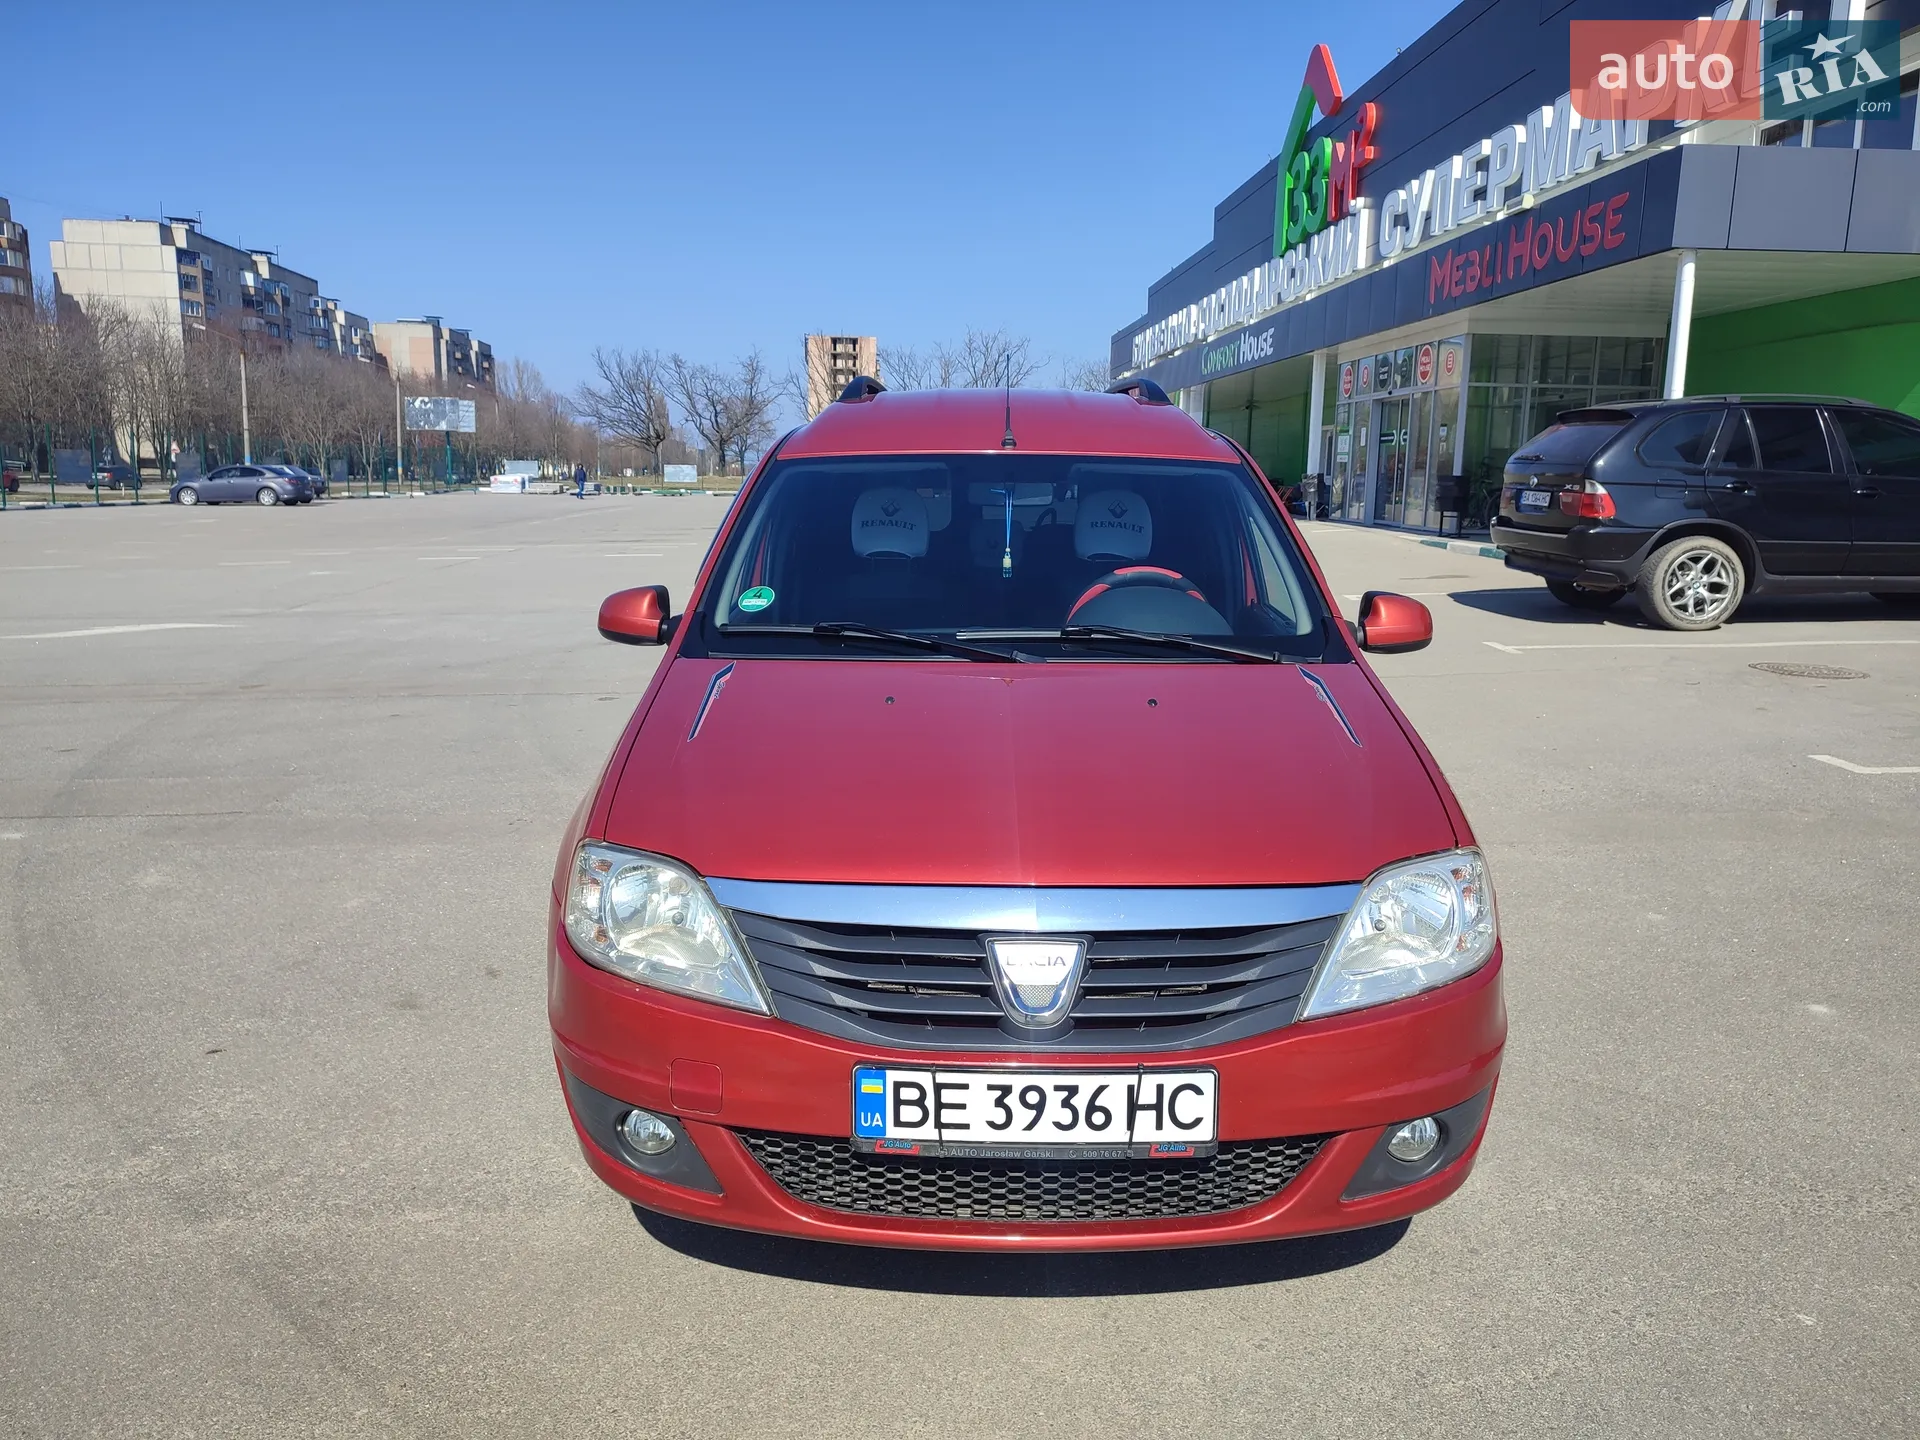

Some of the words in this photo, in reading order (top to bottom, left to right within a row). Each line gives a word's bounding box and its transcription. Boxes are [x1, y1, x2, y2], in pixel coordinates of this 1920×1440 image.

[1507, 191, 1630, 281] HOUSE
[1240, 327, 1275, 364] HOUSE
[860, 519, 916, 531] RENAULT
[1090, 520, 1145, 534] RENAULT
[753, 587, 764, 599] 4
[892, 1081, 970, 1130] BE
[985, 1083, 1113, 1132] 3936
[1126, 1083, 1205, 1131] HC
[860, 1111, 884, 1128] UA
[951, 1148, 978, 1157] AUTO
